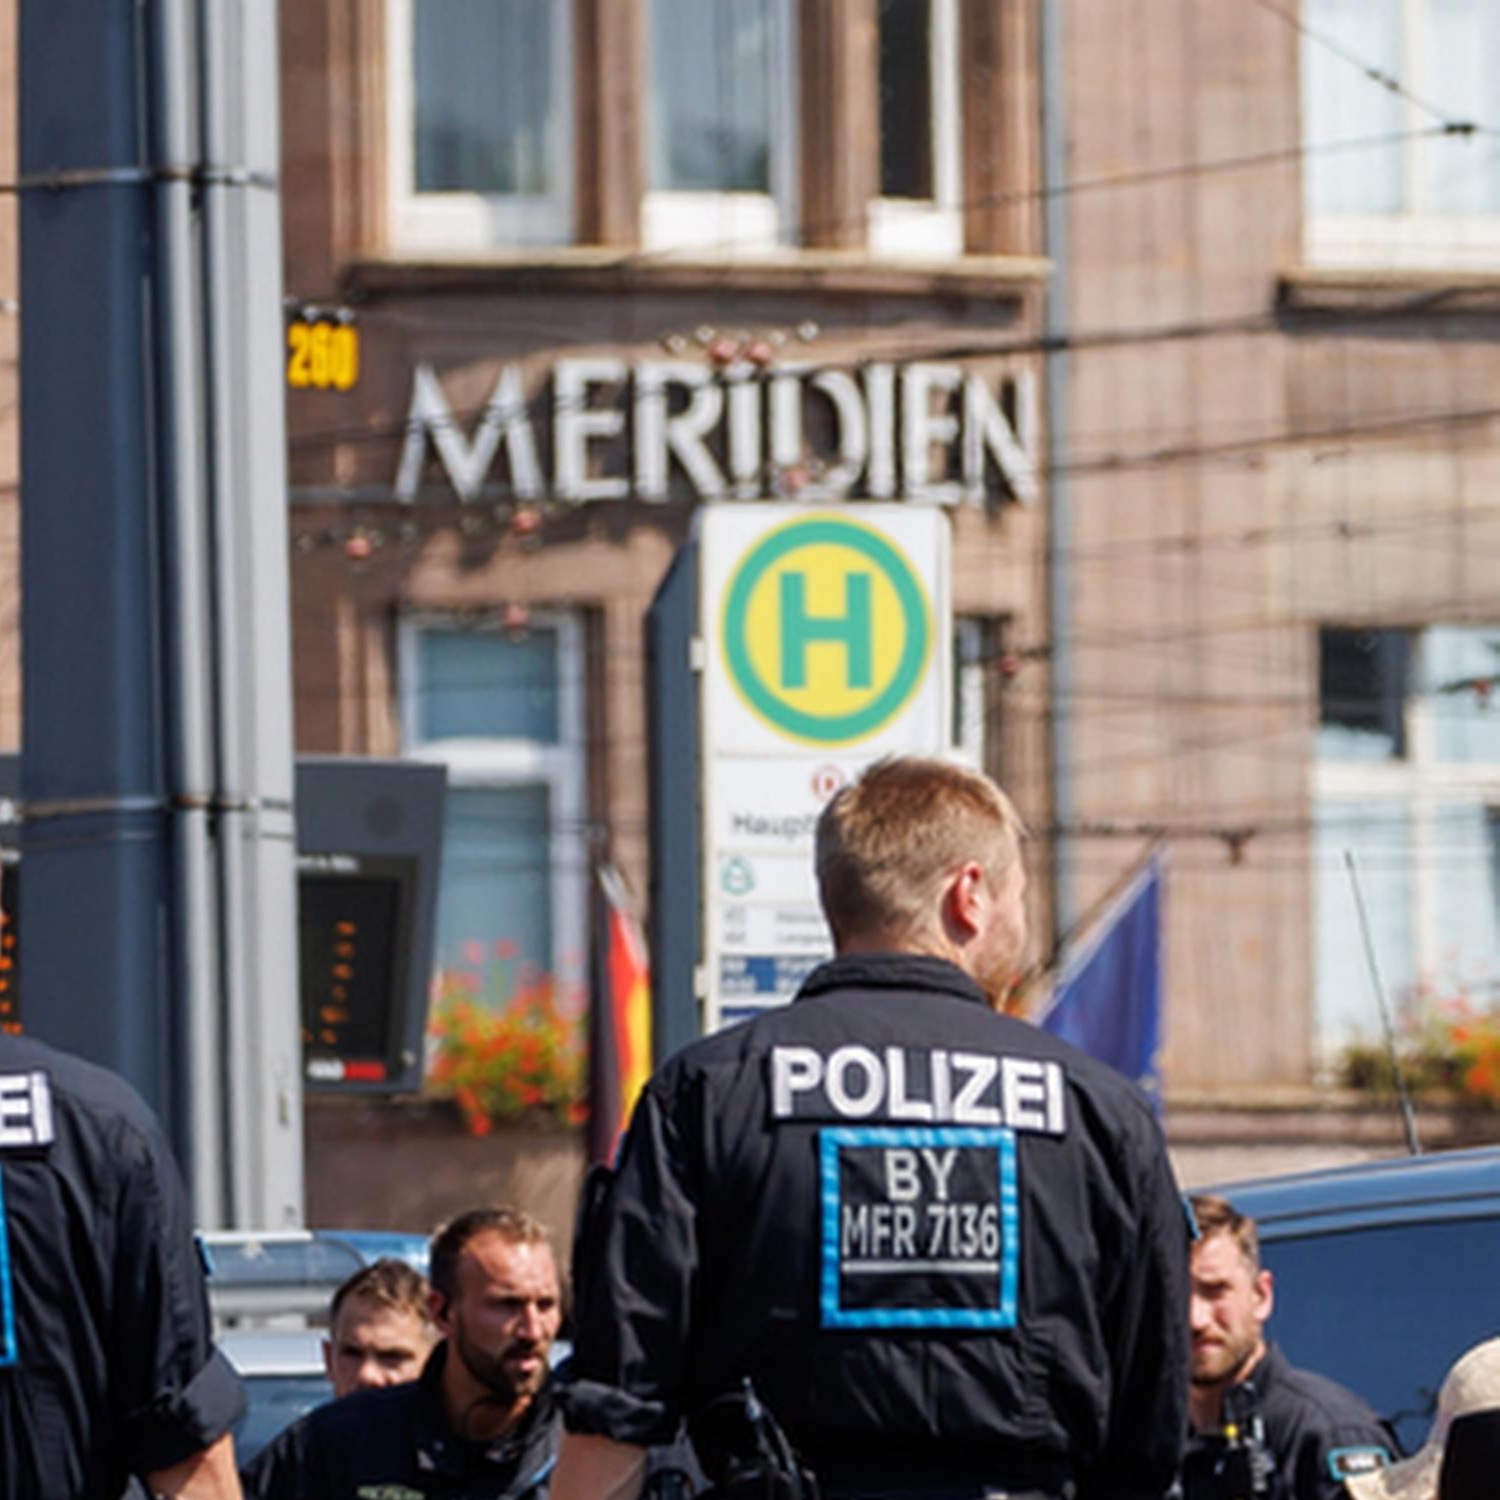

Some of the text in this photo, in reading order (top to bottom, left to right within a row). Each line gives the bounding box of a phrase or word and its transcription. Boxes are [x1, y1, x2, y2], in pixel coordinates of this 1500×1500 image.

[285, 320, 359, 391] 260
[395, 360, 1038, 502] MERIDIEN
[772, 1045, 1067, 1134] POLIZEI
[885, 1148, 957, 1201] BY
[841, 1204, 1000, 1257] MFR 7136
